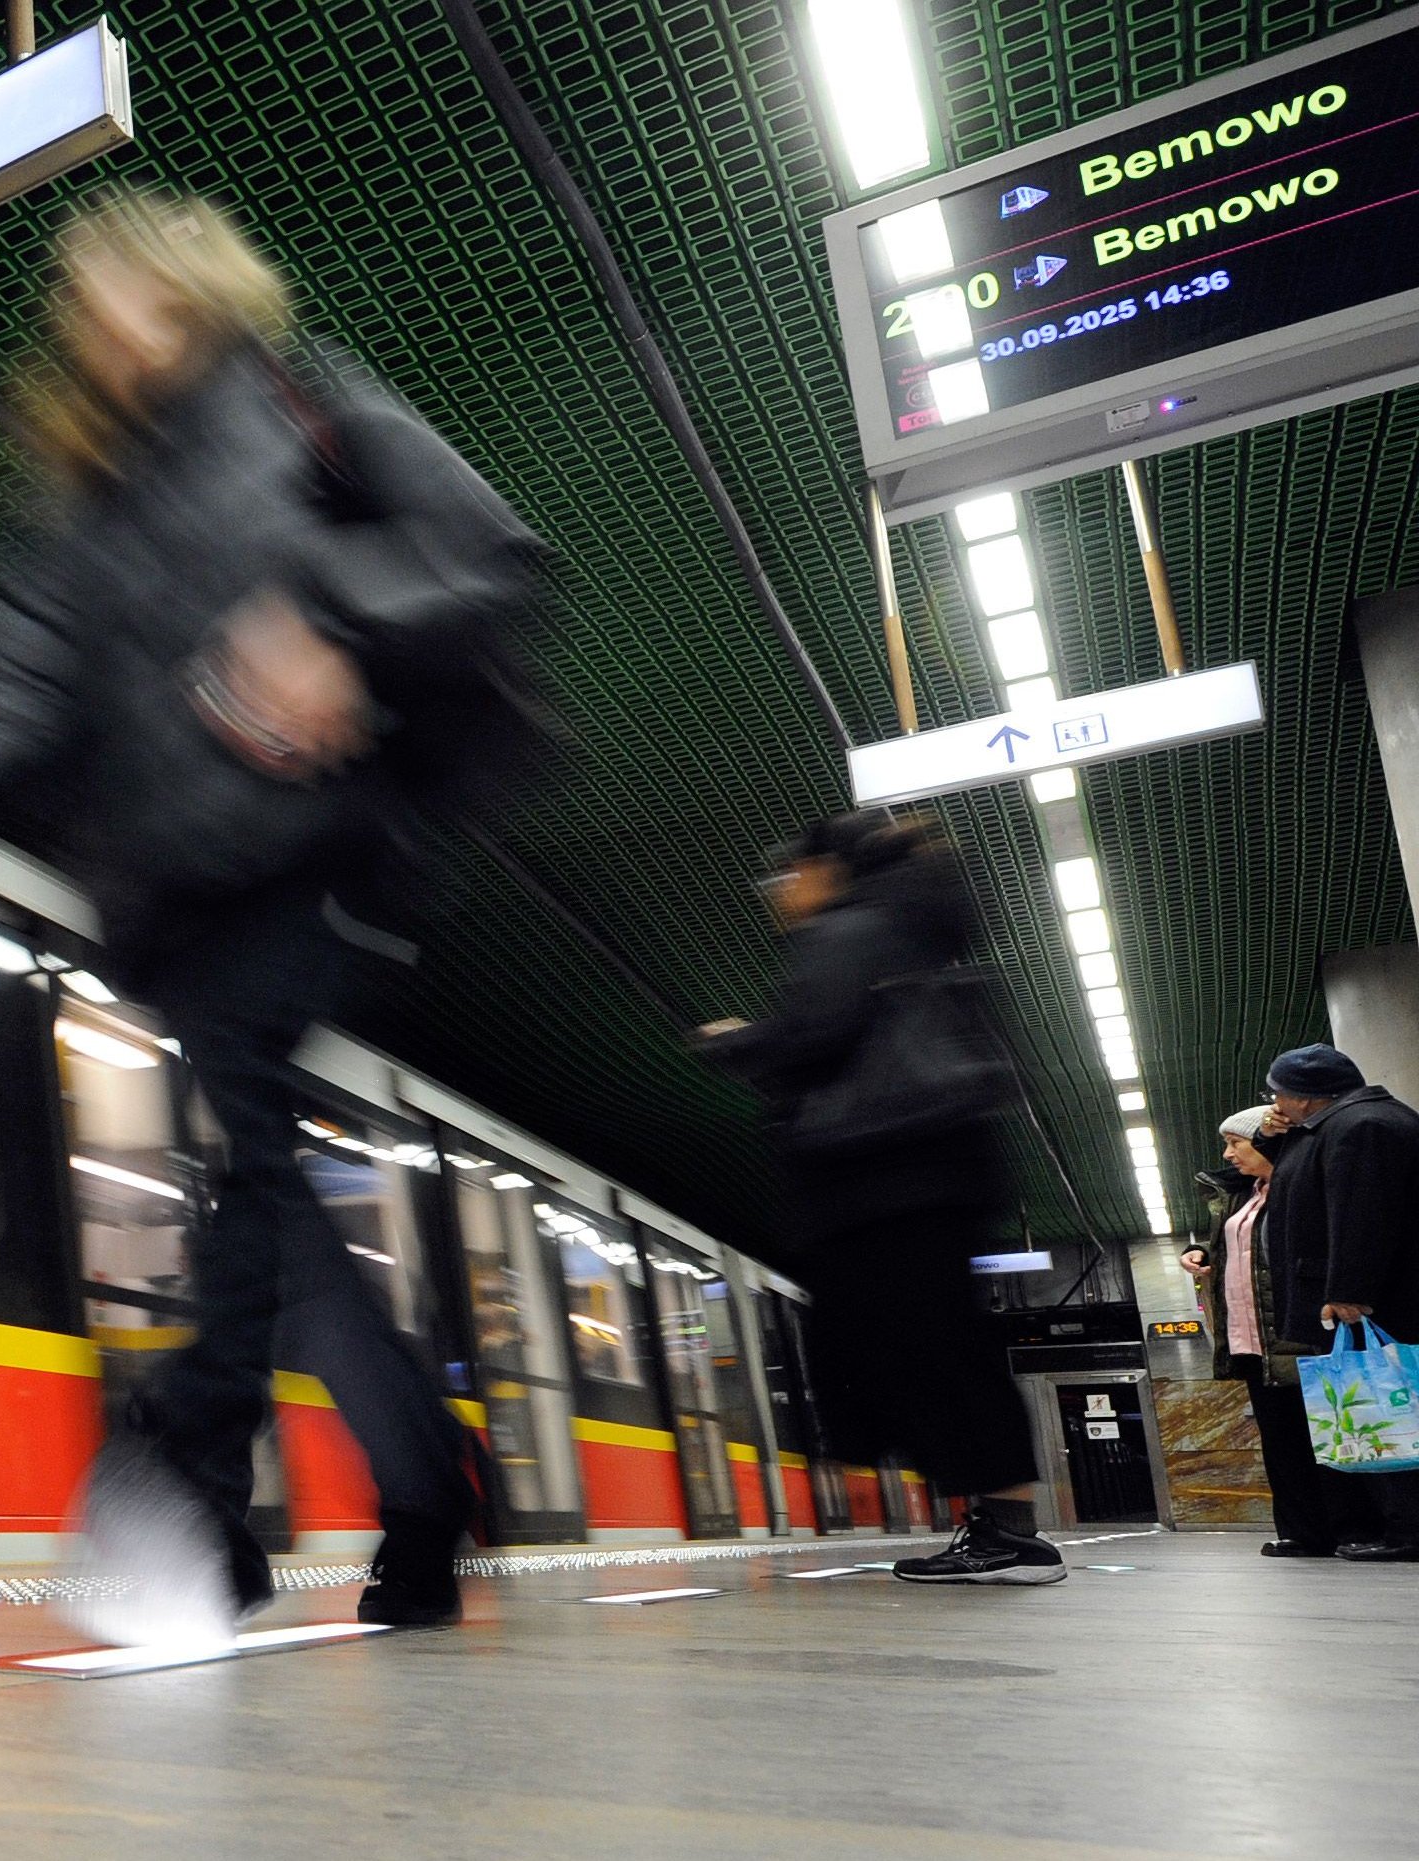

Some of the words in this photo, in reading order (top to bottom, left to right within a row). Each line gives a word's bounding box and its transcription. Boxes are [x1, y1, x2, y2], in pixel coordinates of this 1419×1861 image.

[1079, 84, 1347, 196] Bemowo
[1093, 168, 1339, 266] Bemowo
[980, 298, 1138, 362] 30.09.2025
[1144, 270, 1231, 311] 14:36
[1154, 1322, 1199, 1334] 14:36
